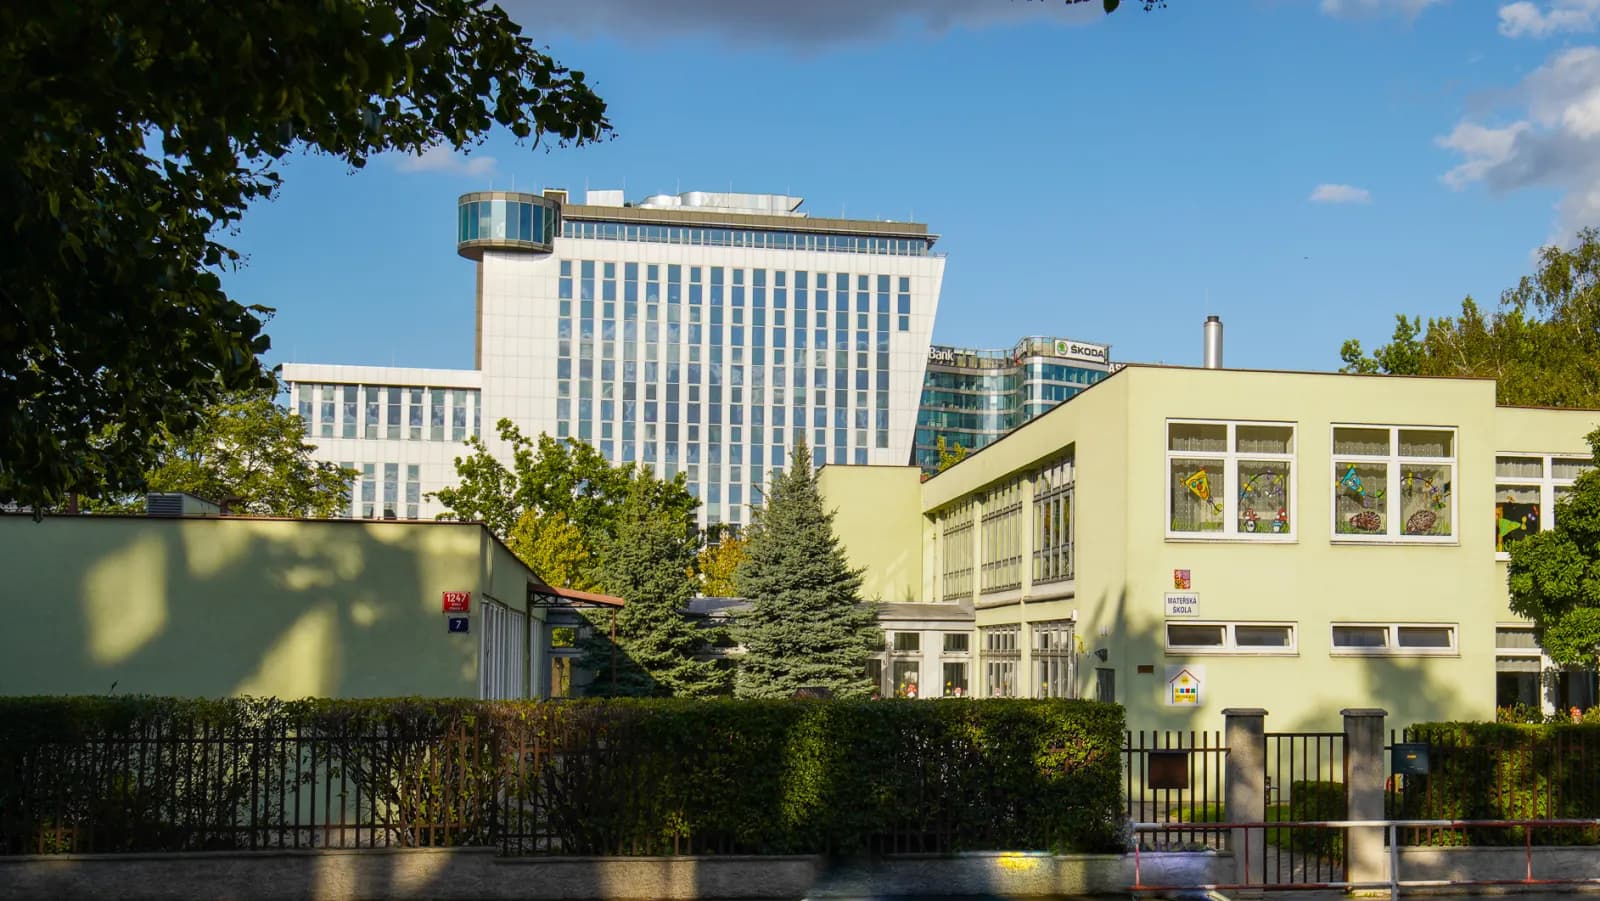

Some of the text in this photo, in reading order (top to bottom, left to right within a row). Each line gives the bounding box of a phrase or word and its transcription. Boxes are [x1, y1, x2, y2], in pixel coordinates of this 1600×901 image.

[928, 346, 954, 361] Bank
[1070, 344, 1104, 358] ŠKODA
[446, 593, 466, 602] 1247
[1167, 596, 1197, 604] MATEŘSKÁ
[1172, 605, 1192, 614] ŠKOLA
[455, 620, 462, 629] 7
